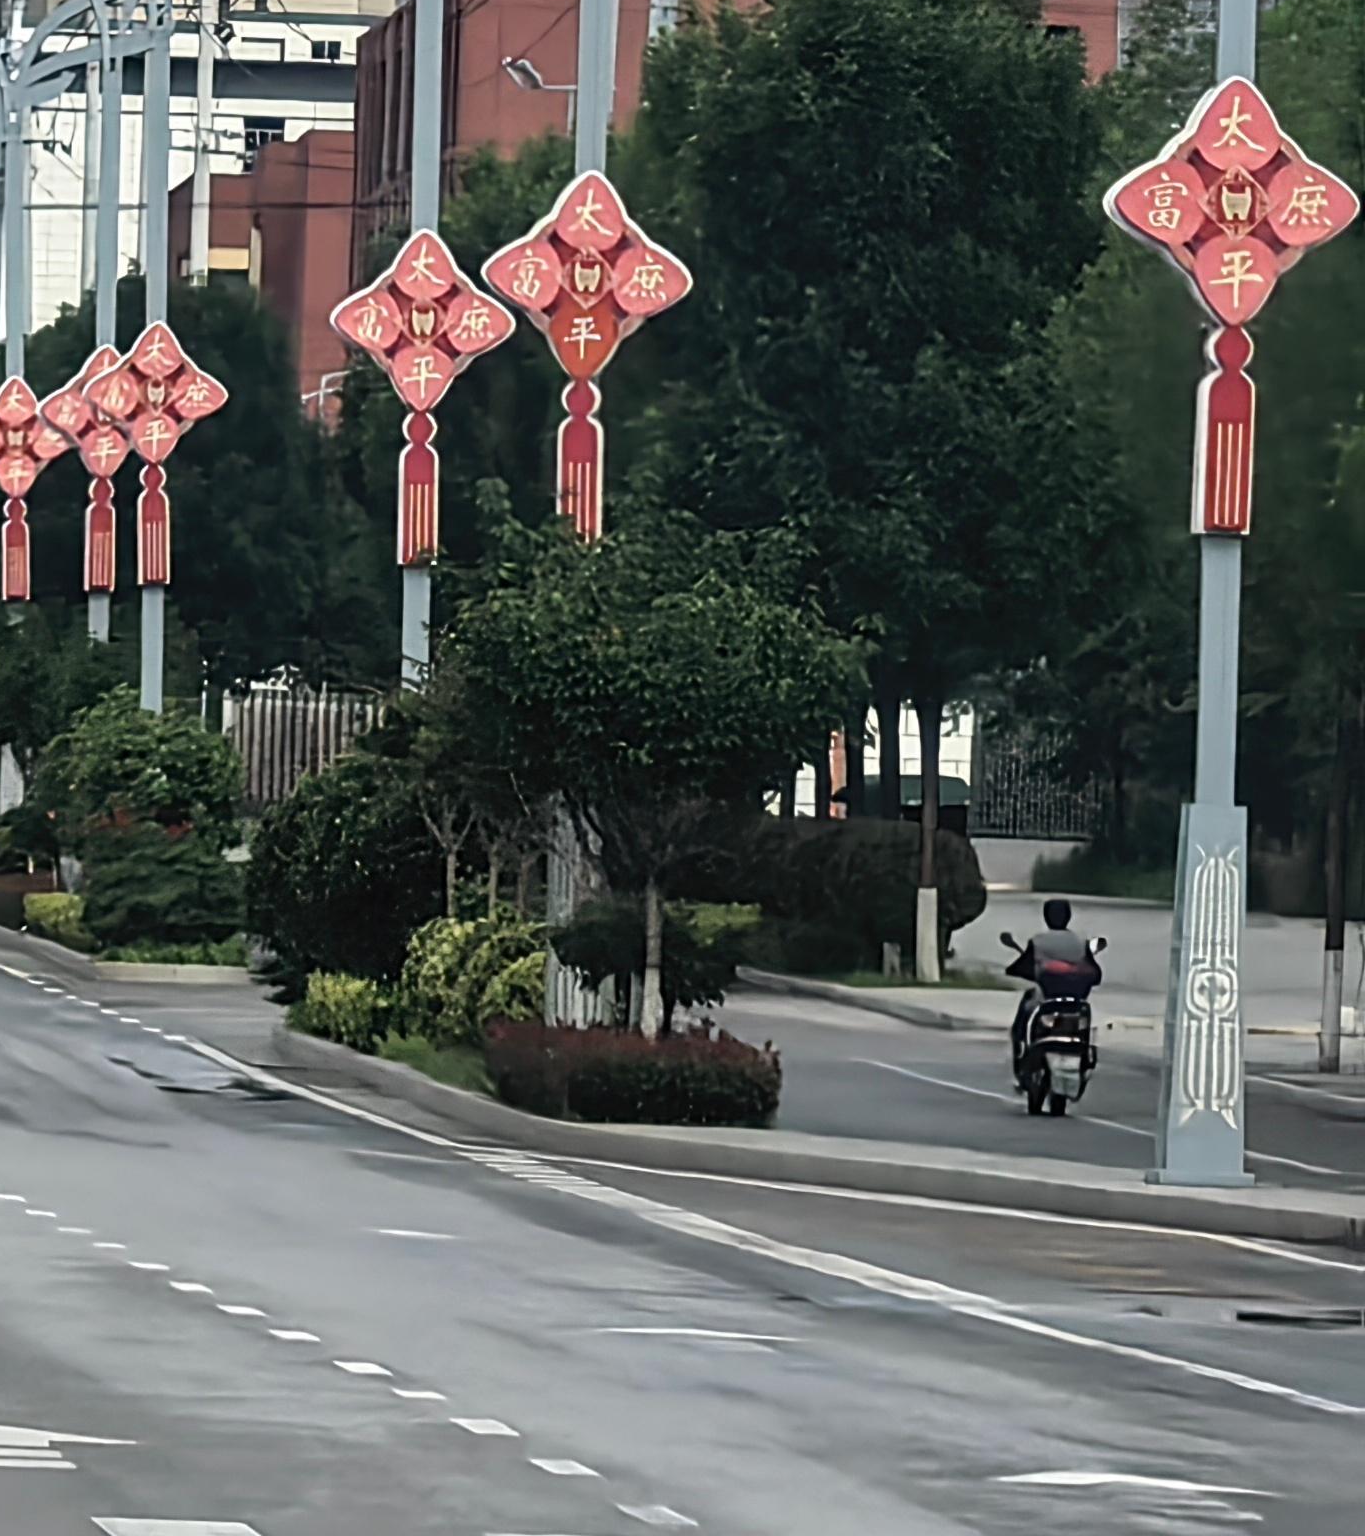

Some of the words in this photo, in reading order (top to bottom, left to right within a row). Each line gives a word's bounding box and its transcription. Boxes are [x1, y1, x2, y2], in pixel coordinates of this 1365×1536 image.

[1212, 95, 1266, 152] 太
[569, 188, 615, 236] 太
[1144, 171, 1188, 230] 富
[1279, 175, 1333, 227] 庶
[405, 240, 446, 286] 太
[508, 247, 548, 299] 富
[621, 253, 667, 301] 庶
[1208, 250, 1265, 308] 平
[351, 296, 390, 342] 富
[452, 298, 496, 340] 庶
[563, 317, 602, 361] 平
[402, 355, 443, 400] 平
[138, 418, 174, 457] 平
